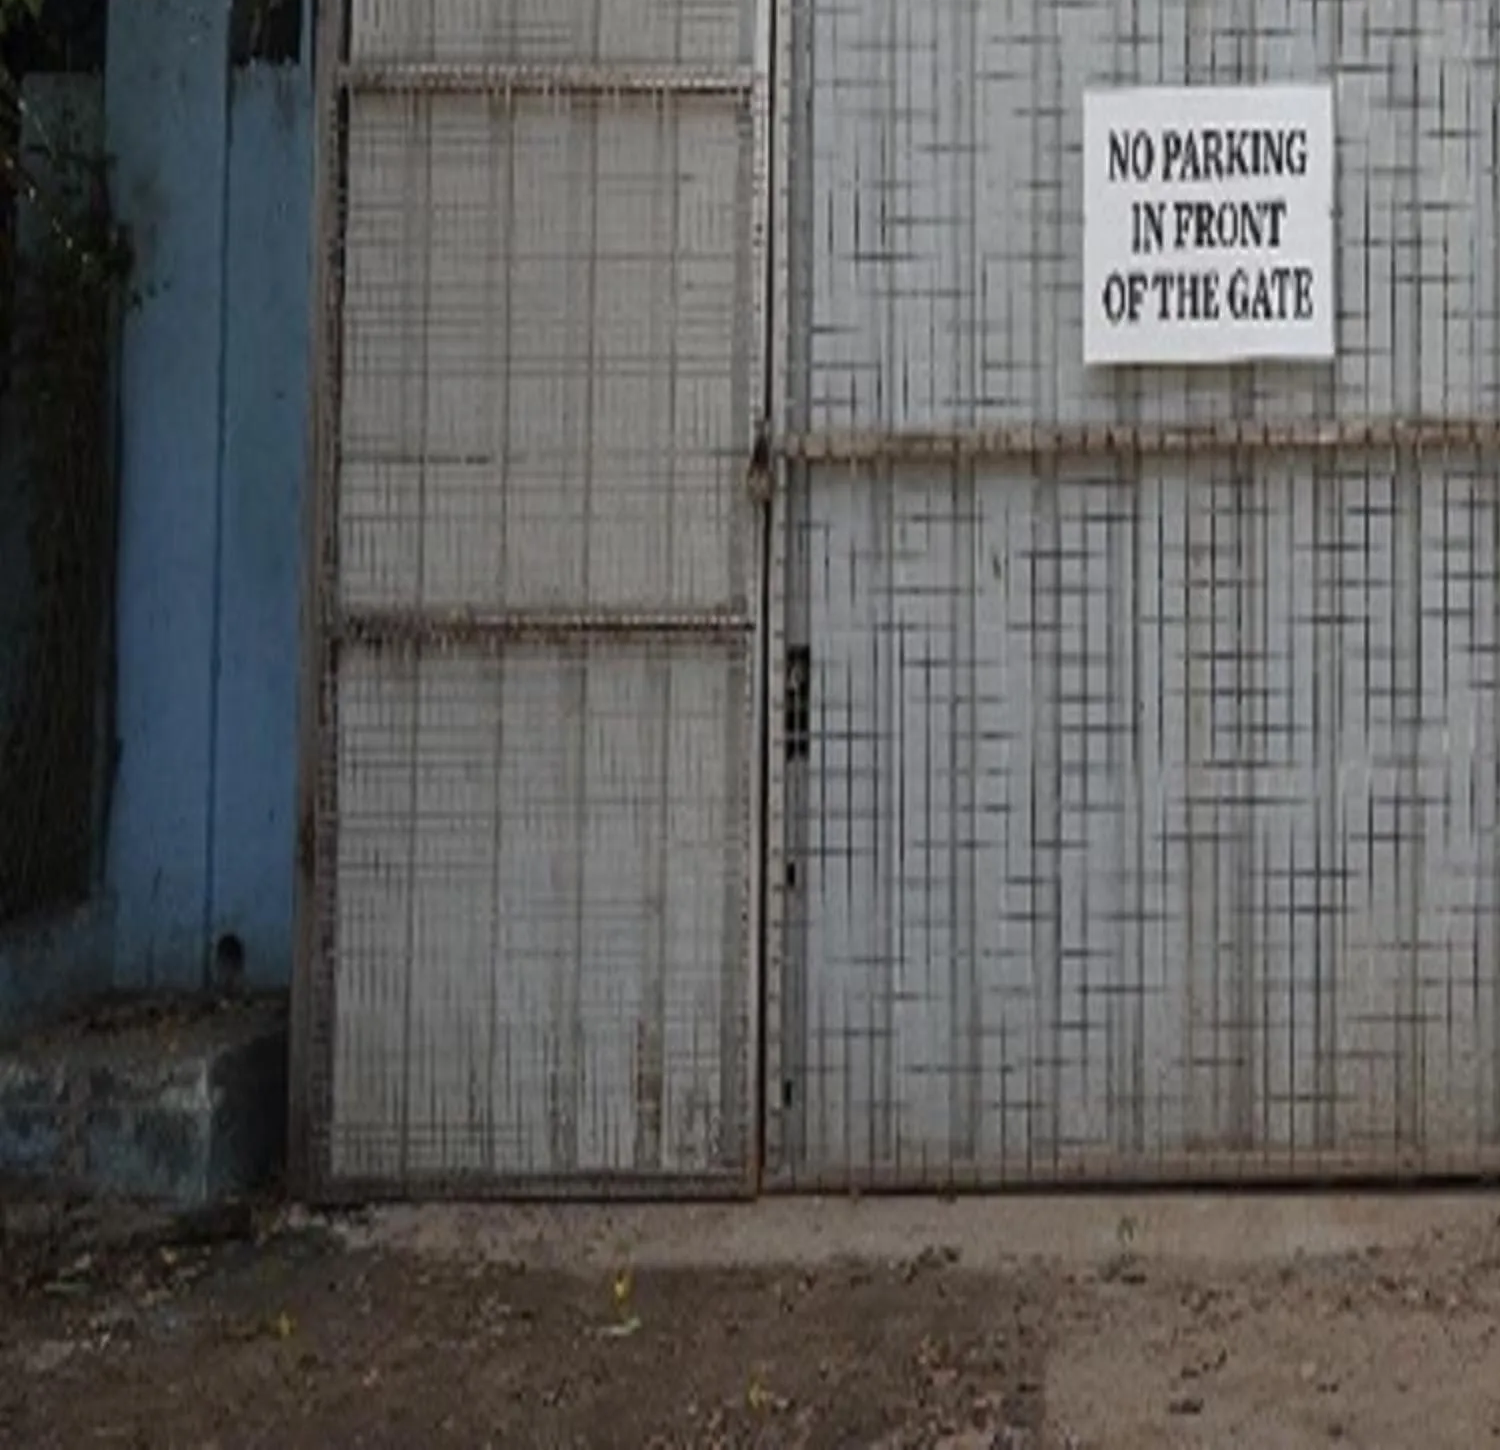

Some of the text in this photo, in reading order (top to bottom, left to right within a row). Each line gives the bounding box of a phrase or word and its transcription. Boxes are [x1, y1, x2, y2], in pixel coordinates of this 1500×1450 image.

[1108, 128, 1307, 182] NO PARKING
[1132, 200, 1288, 254] IN FRONT
[1103, 267, 1314, 324] OF THE GATE
